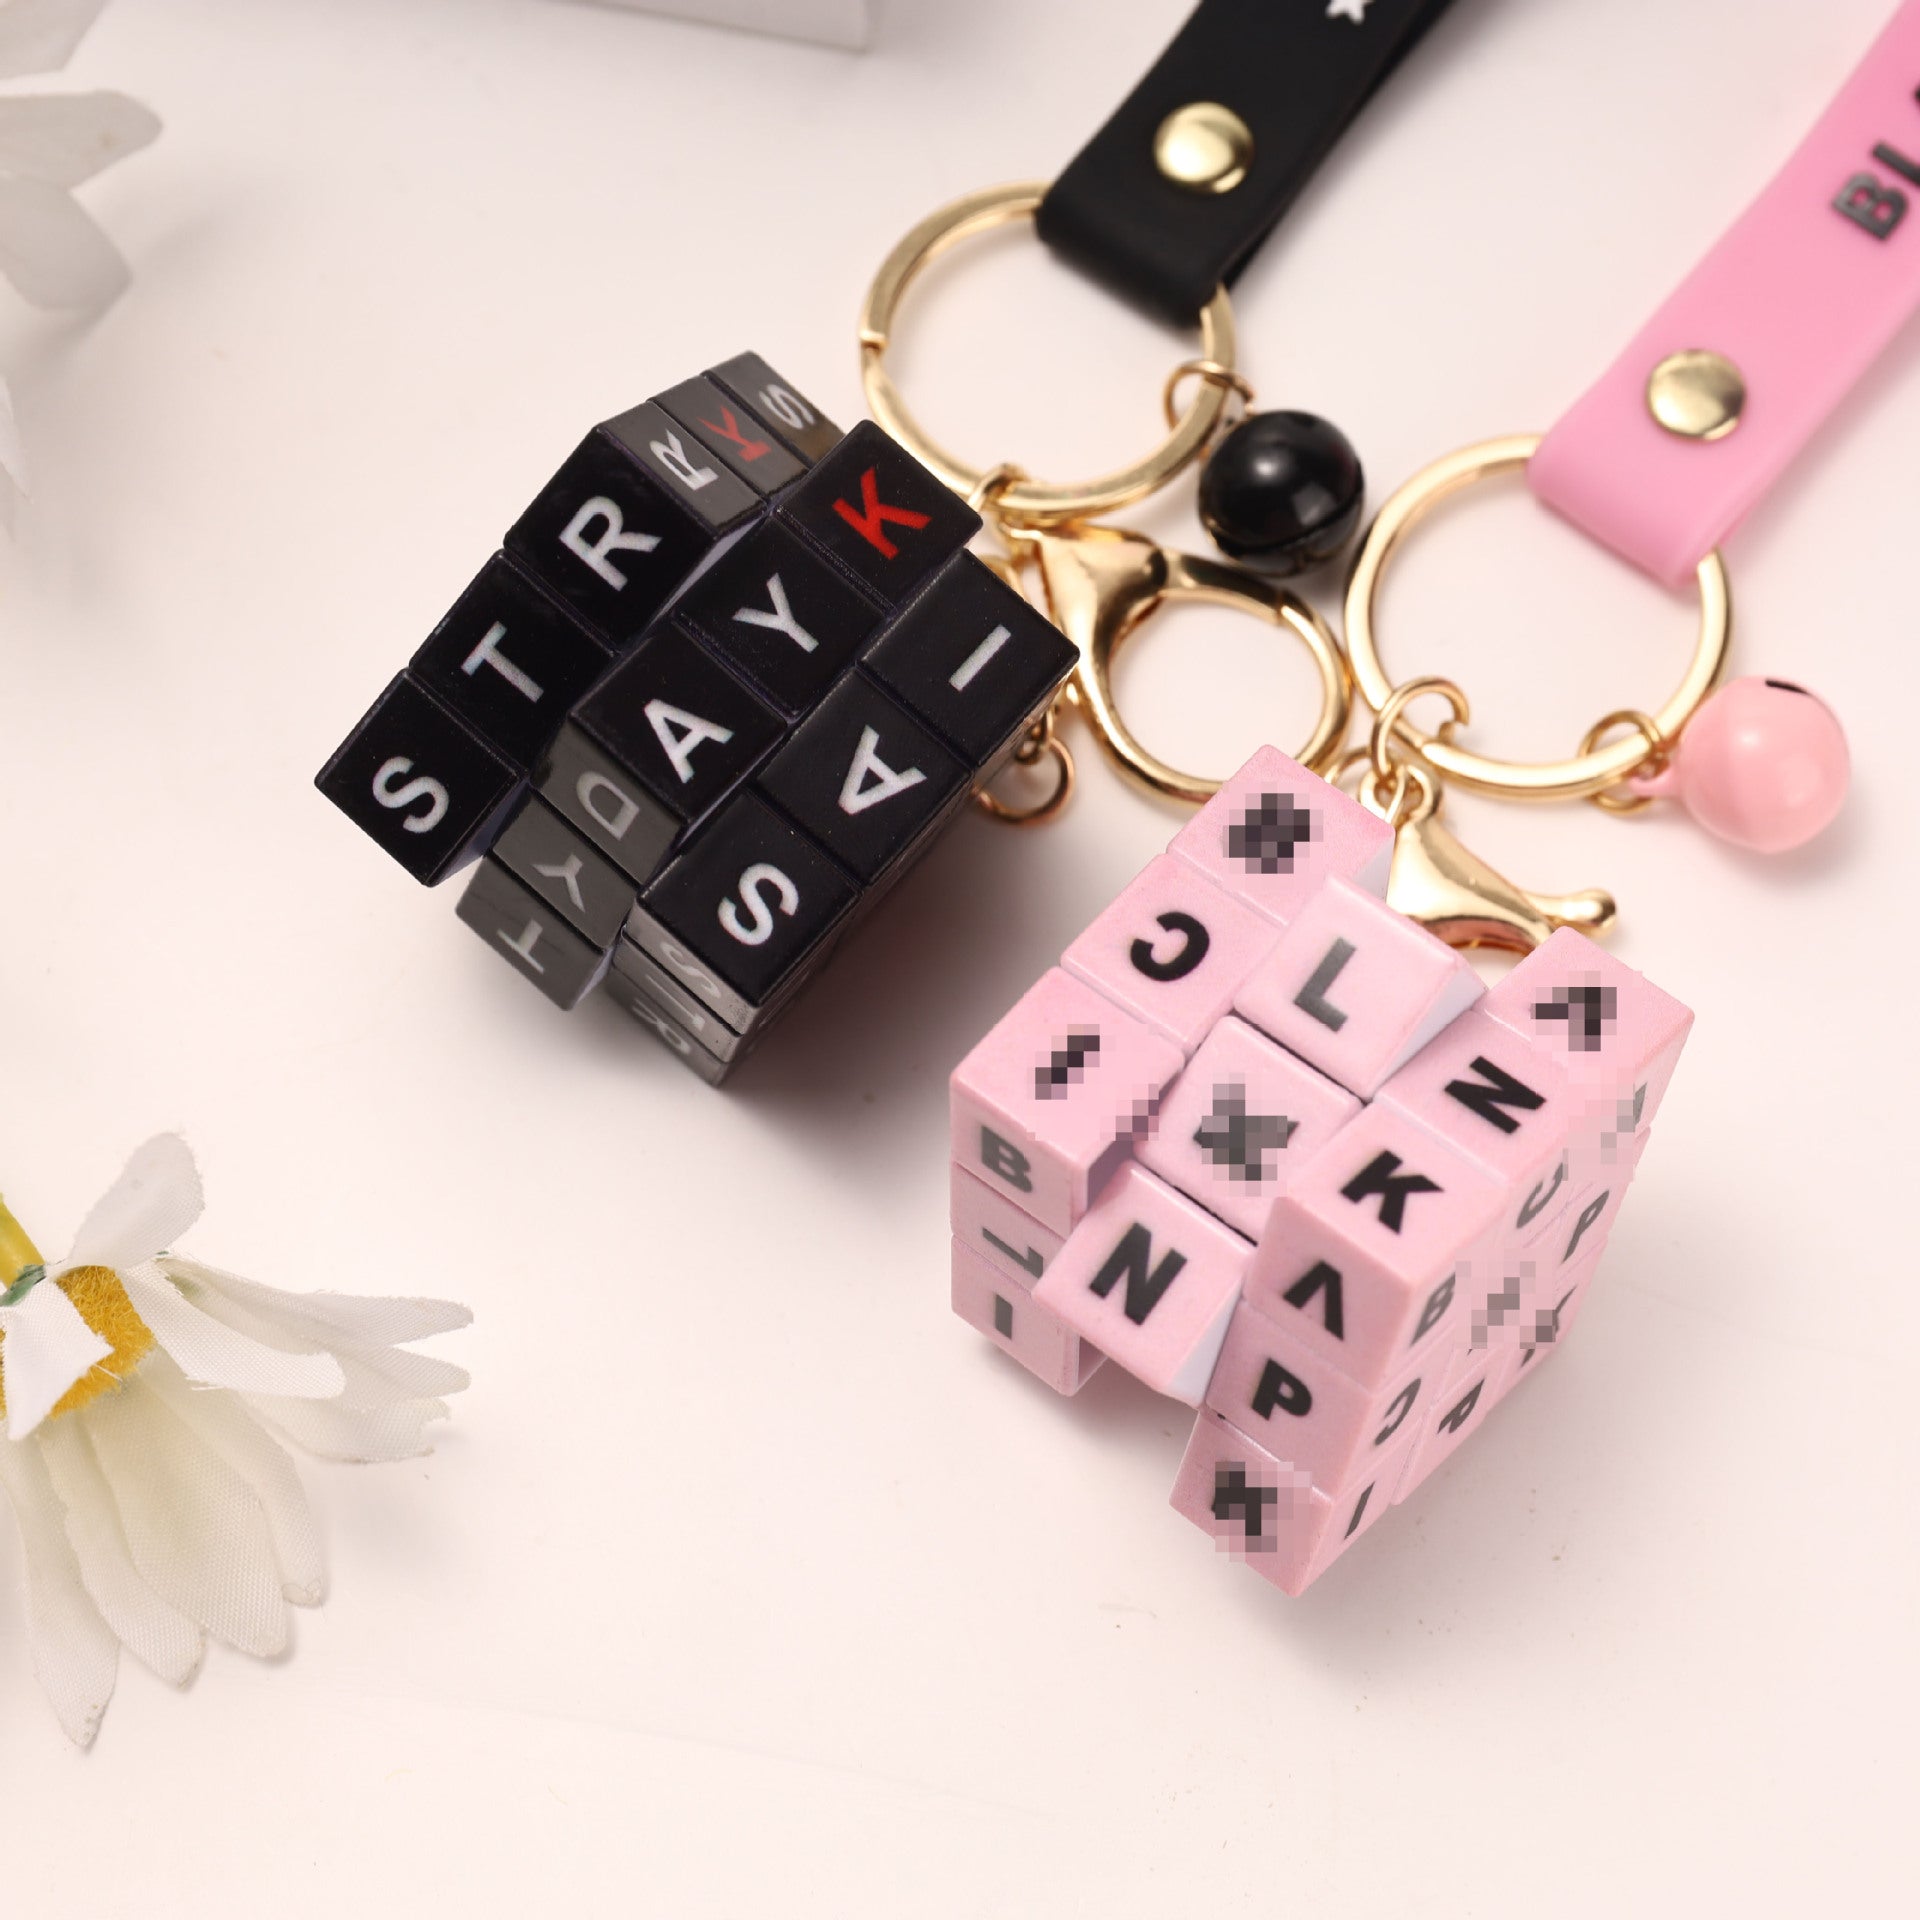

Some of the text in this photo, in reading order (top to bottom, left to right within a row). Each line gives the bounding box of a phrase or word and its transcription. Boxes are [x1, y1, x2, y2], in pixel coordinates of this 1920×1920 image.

[650, 428, 719, 491] R
[696, 405, 772, 462] K
[644, 467, 931, 784] A Y K
[371, 496, 662, 834] S T R
[576, 770, 641, 841] D
[717, 862, 800, 946] S
[839, 726, 927, 815] A
[531, 853, 586, 914] Y
[1129, 911, 1212, 983] C
[1292, 937, 1357, 1034] L
[978, 1124, 1034, 1195] B
[1339, 1149, 1445, 1235] K
[1088, 1222, 1189, 1326] N
[1250, 1356, 1314, 1422] P
